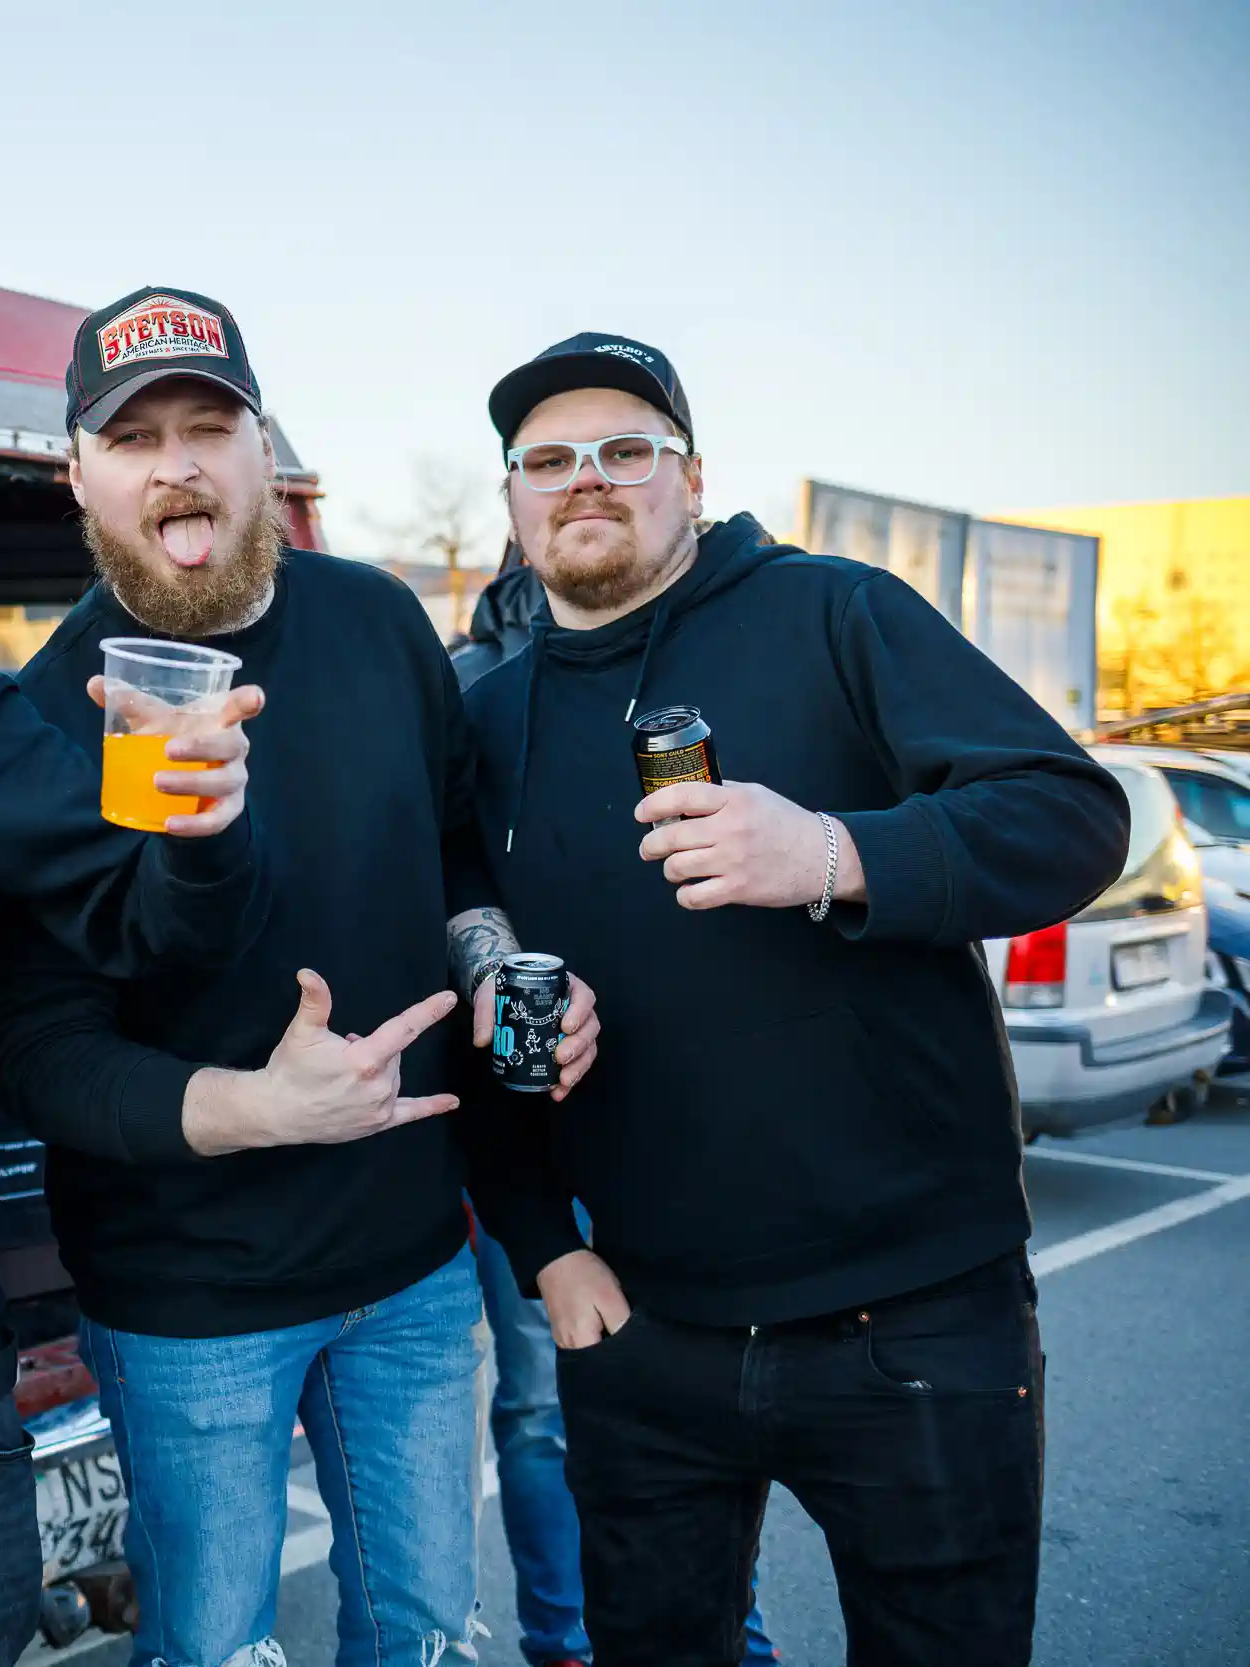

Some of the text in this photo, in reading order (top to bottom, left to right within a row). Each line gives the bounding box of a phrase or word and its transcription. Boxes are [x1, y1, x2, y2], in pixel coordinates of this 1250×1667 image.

[102, 310, 223, 364] STETSON
[122, 337, 210, 360] AMERICAN HERITAGE
